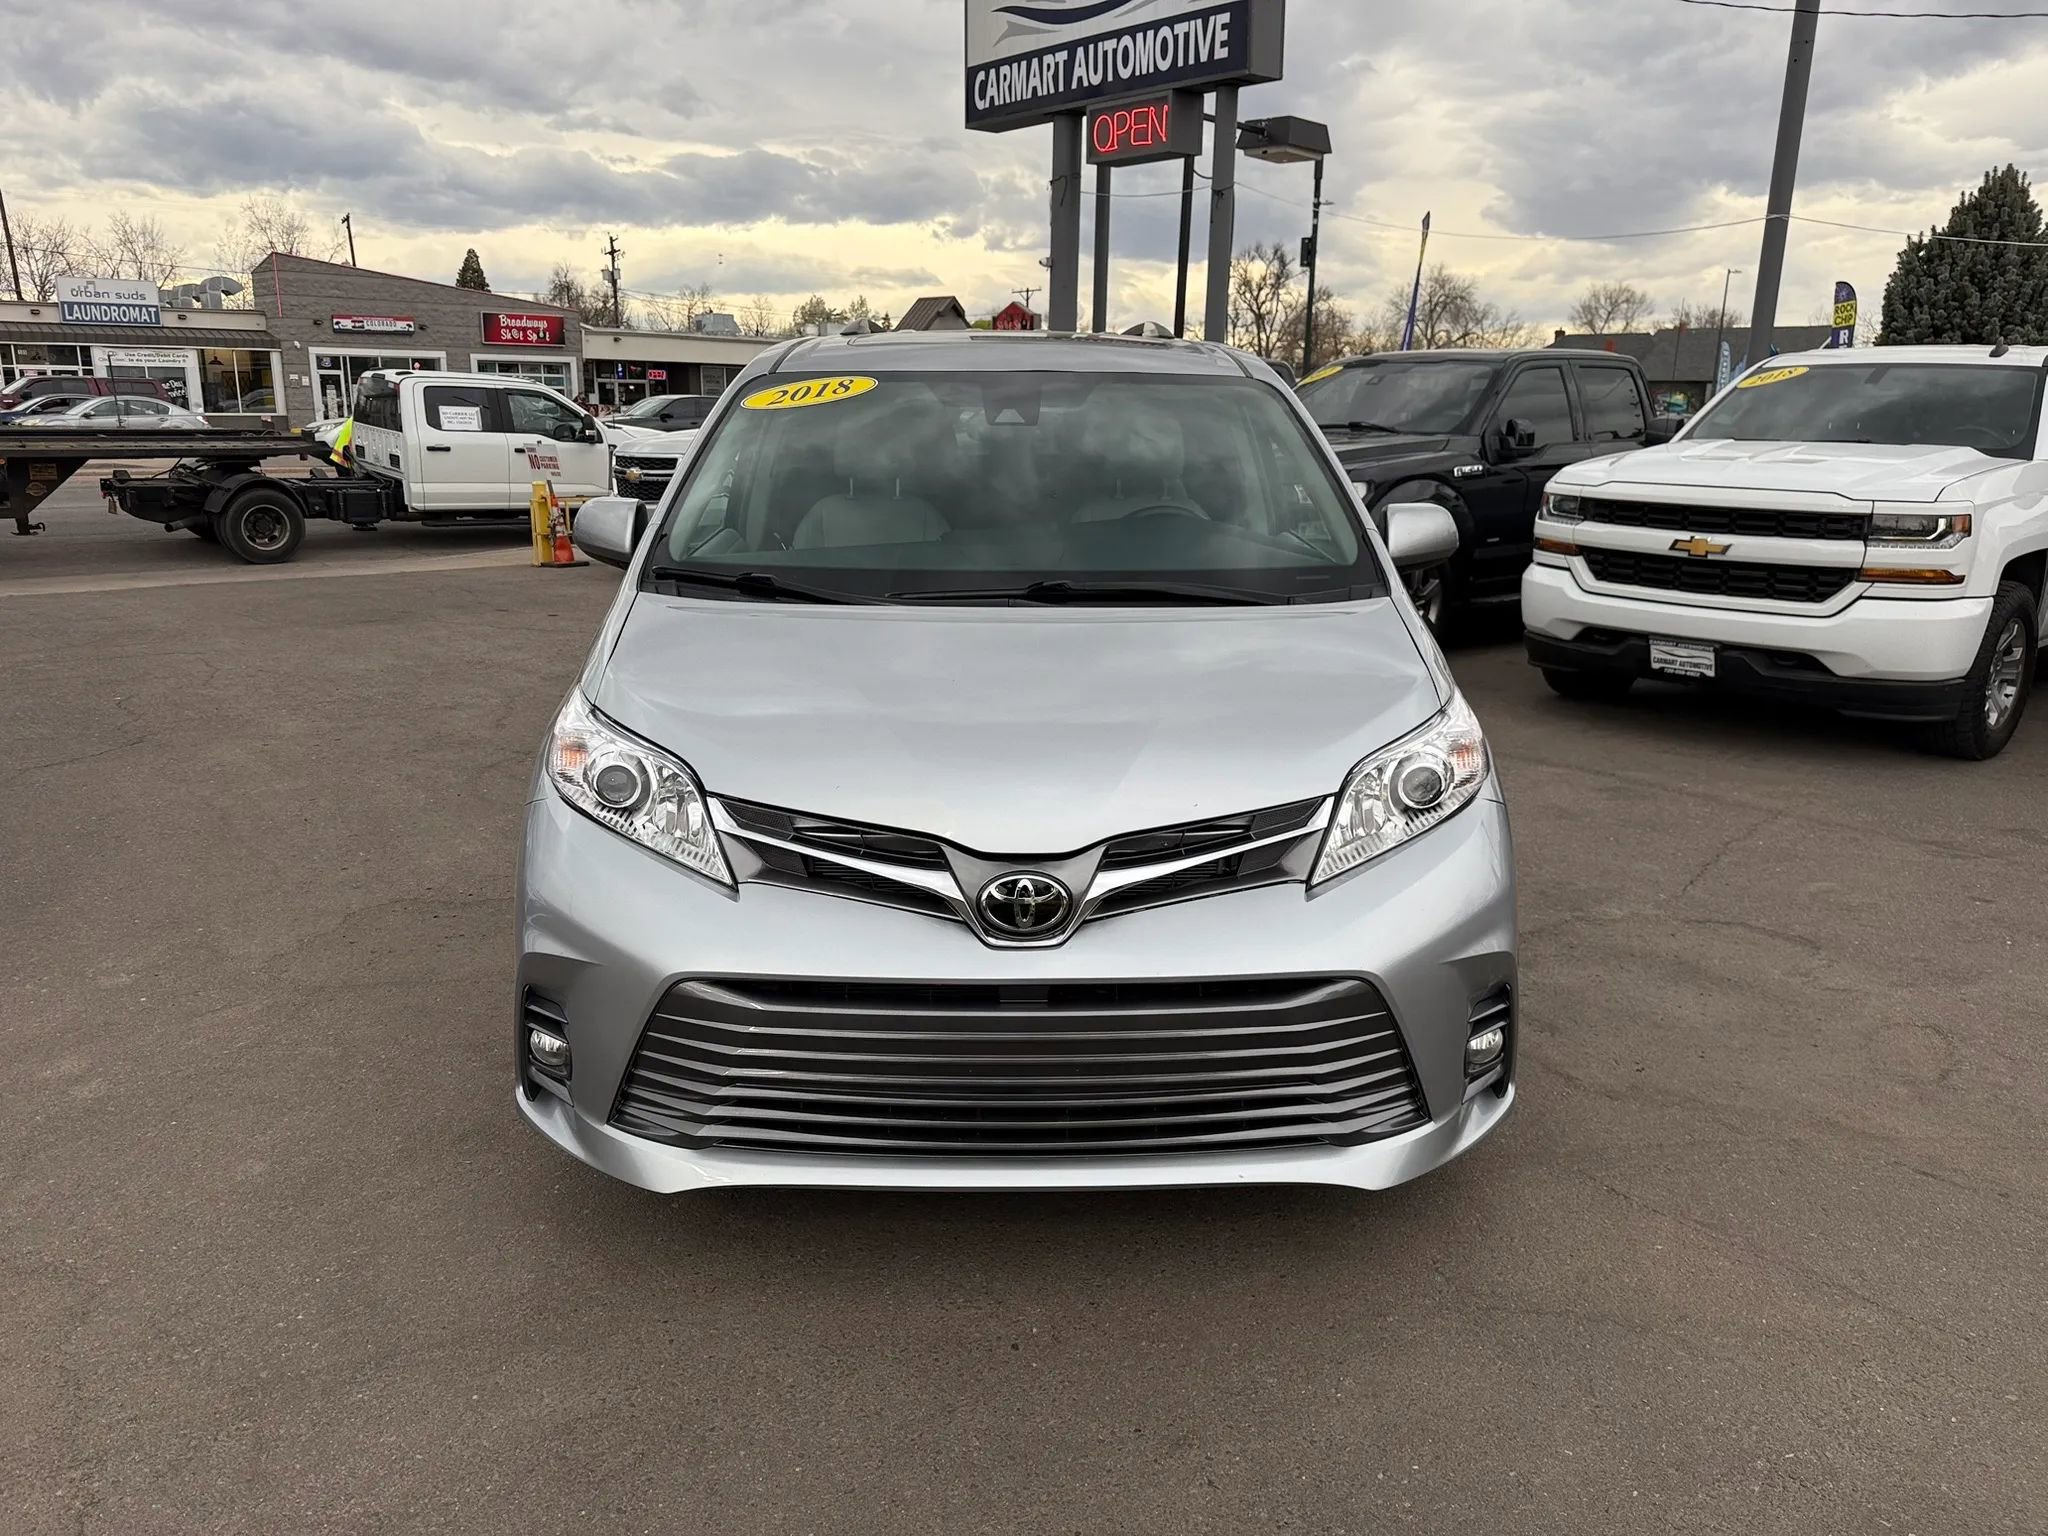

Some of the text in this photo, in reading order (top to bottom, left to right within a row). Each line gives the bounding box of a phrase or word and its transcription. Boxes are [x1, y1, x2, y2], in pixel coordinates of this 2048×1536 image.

[974, 12, 1231, 110] CARMART AUTOMOTIVE
[1093, 104, 1168, 152] OPEN
[63, 303, 157, 323] LAUNDROMAT
[1834, 313, 1853, 326] CHIP
[365, 320, 397, 328] COLORADO
[498, 314, 548, 330] Broadways
[767, 379, 854, 406] 2018
[528, 454, 541, 470] NO
[1653, 656, 1713, 671] CARMART AUTOMOTIVE
